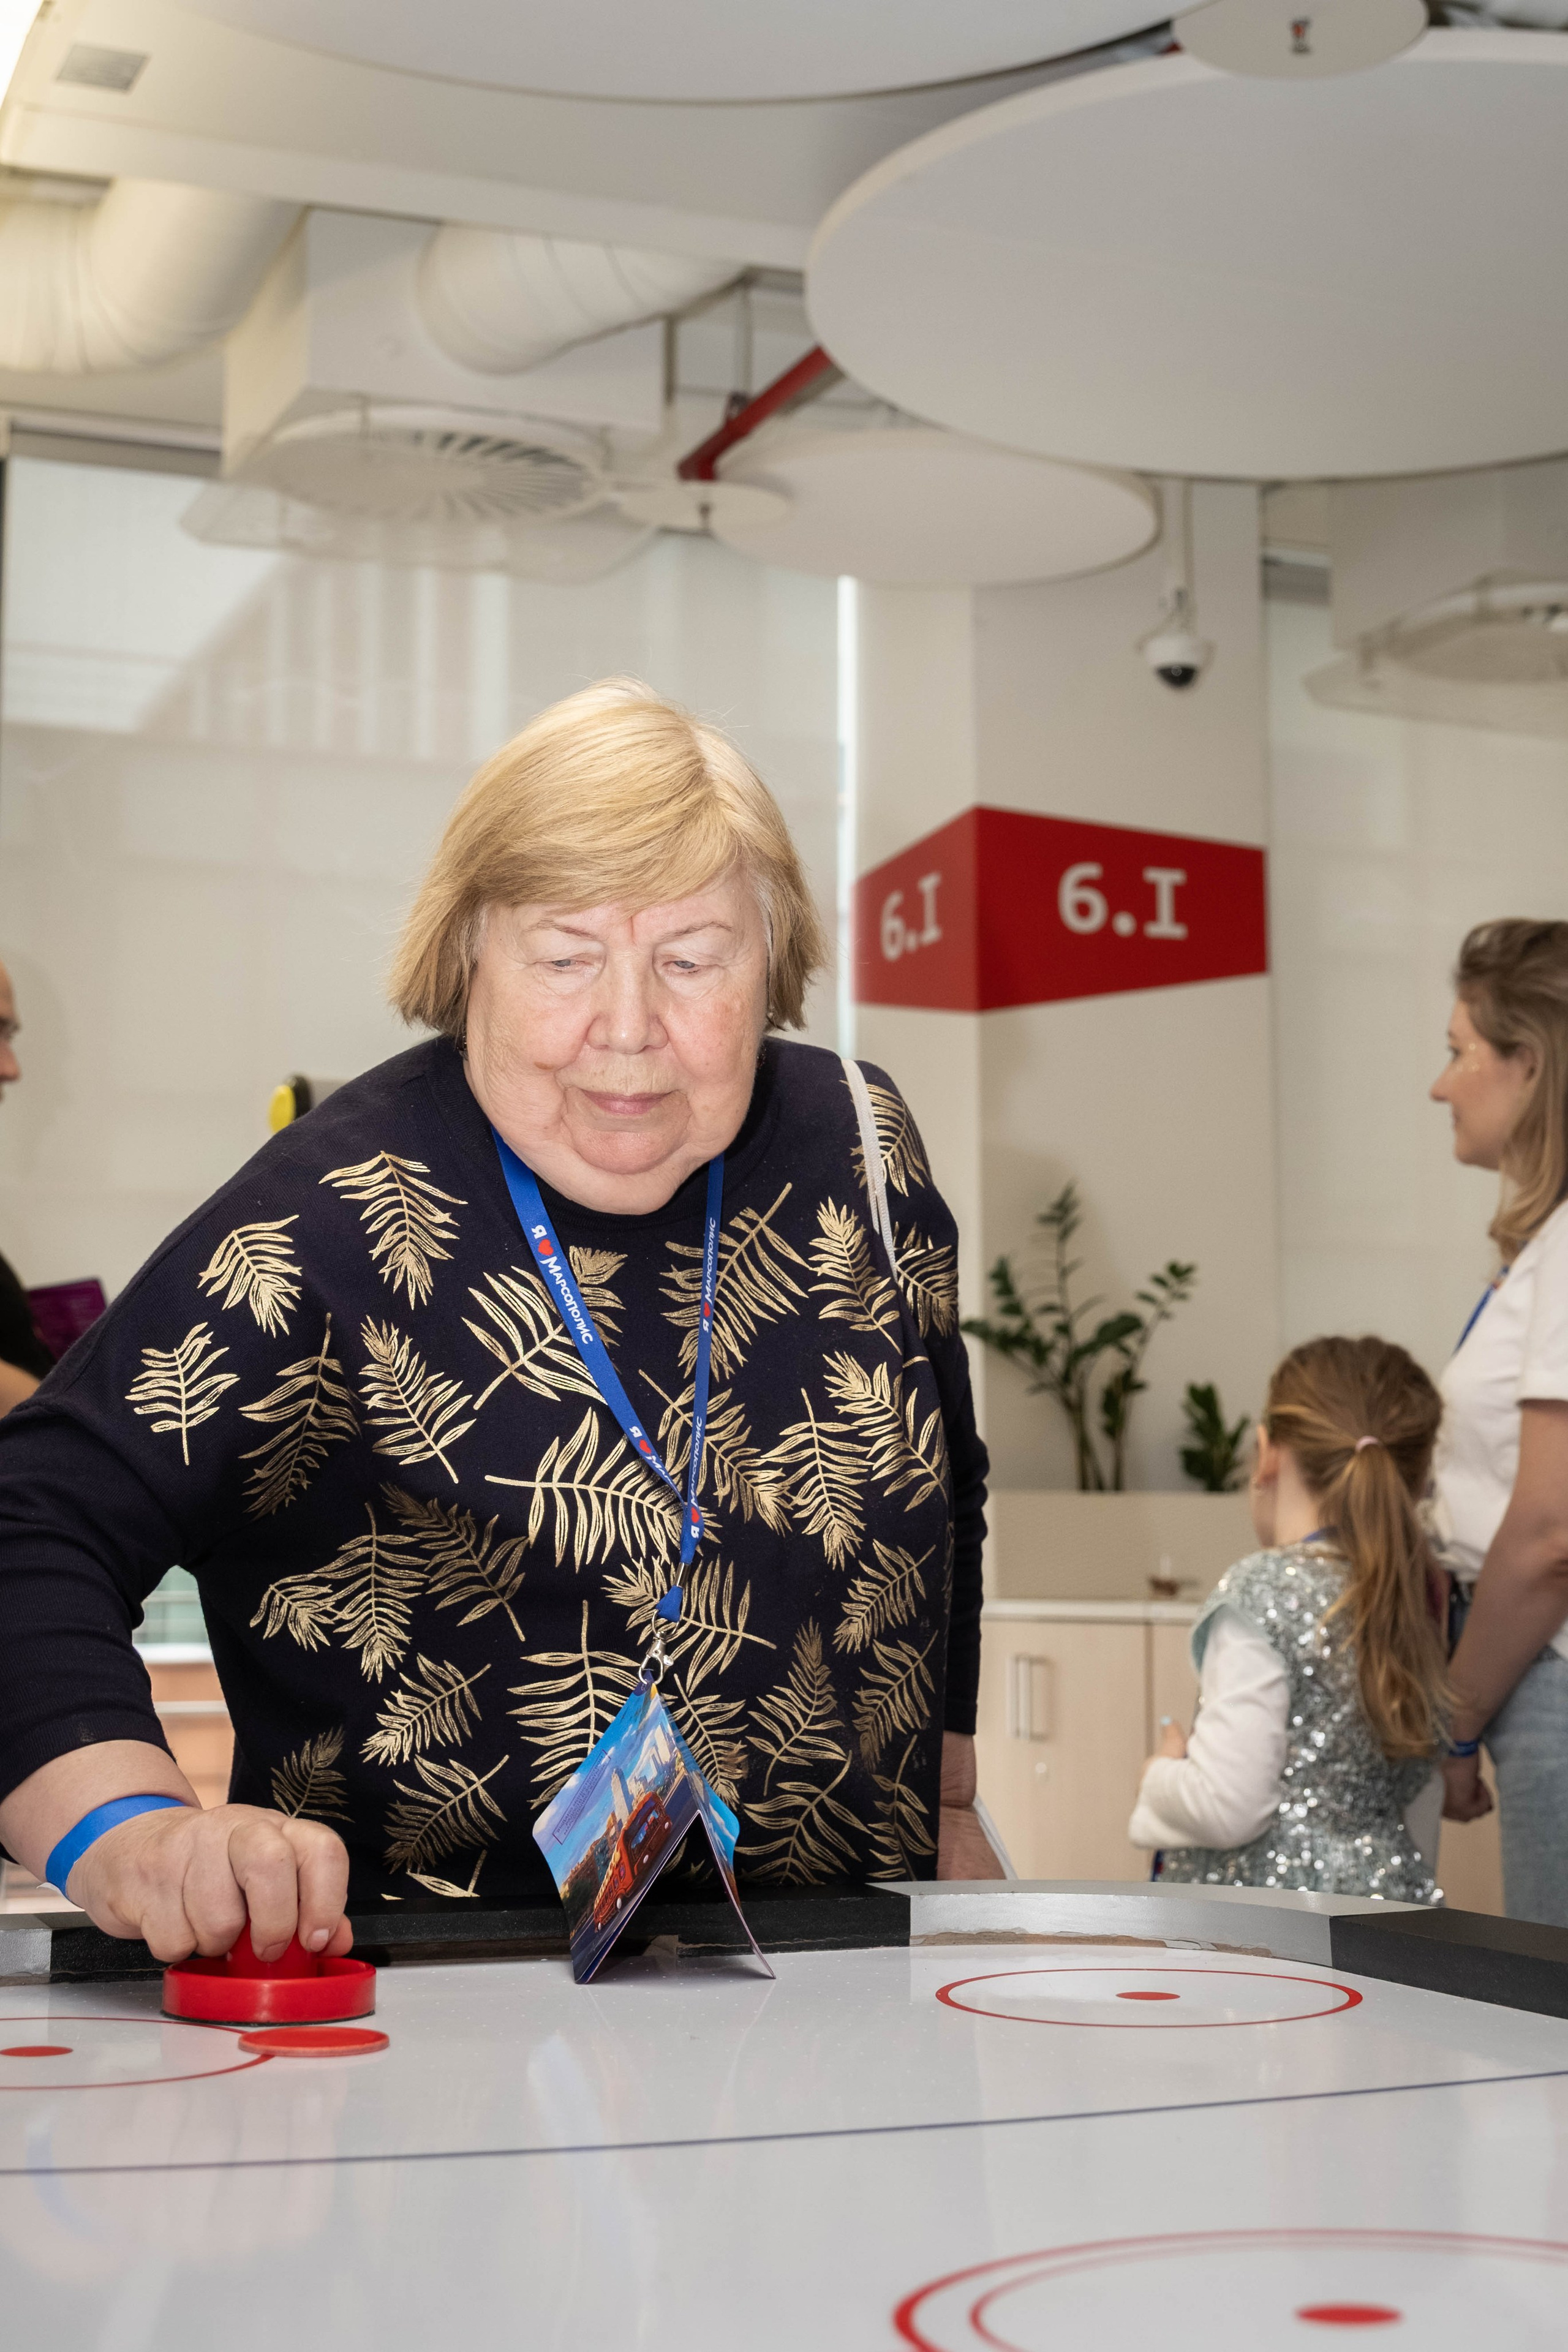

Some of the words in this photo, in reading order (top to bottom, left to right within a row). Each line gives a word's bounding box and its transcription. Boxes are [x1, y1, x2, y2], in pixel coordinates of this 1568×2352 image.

[531, 1225, 547, 1239] Я
[703, 1318, 709, 1333] Я
[629, 1426, 643, 1438] Я
[691, 1525, 699, 1539] Я
